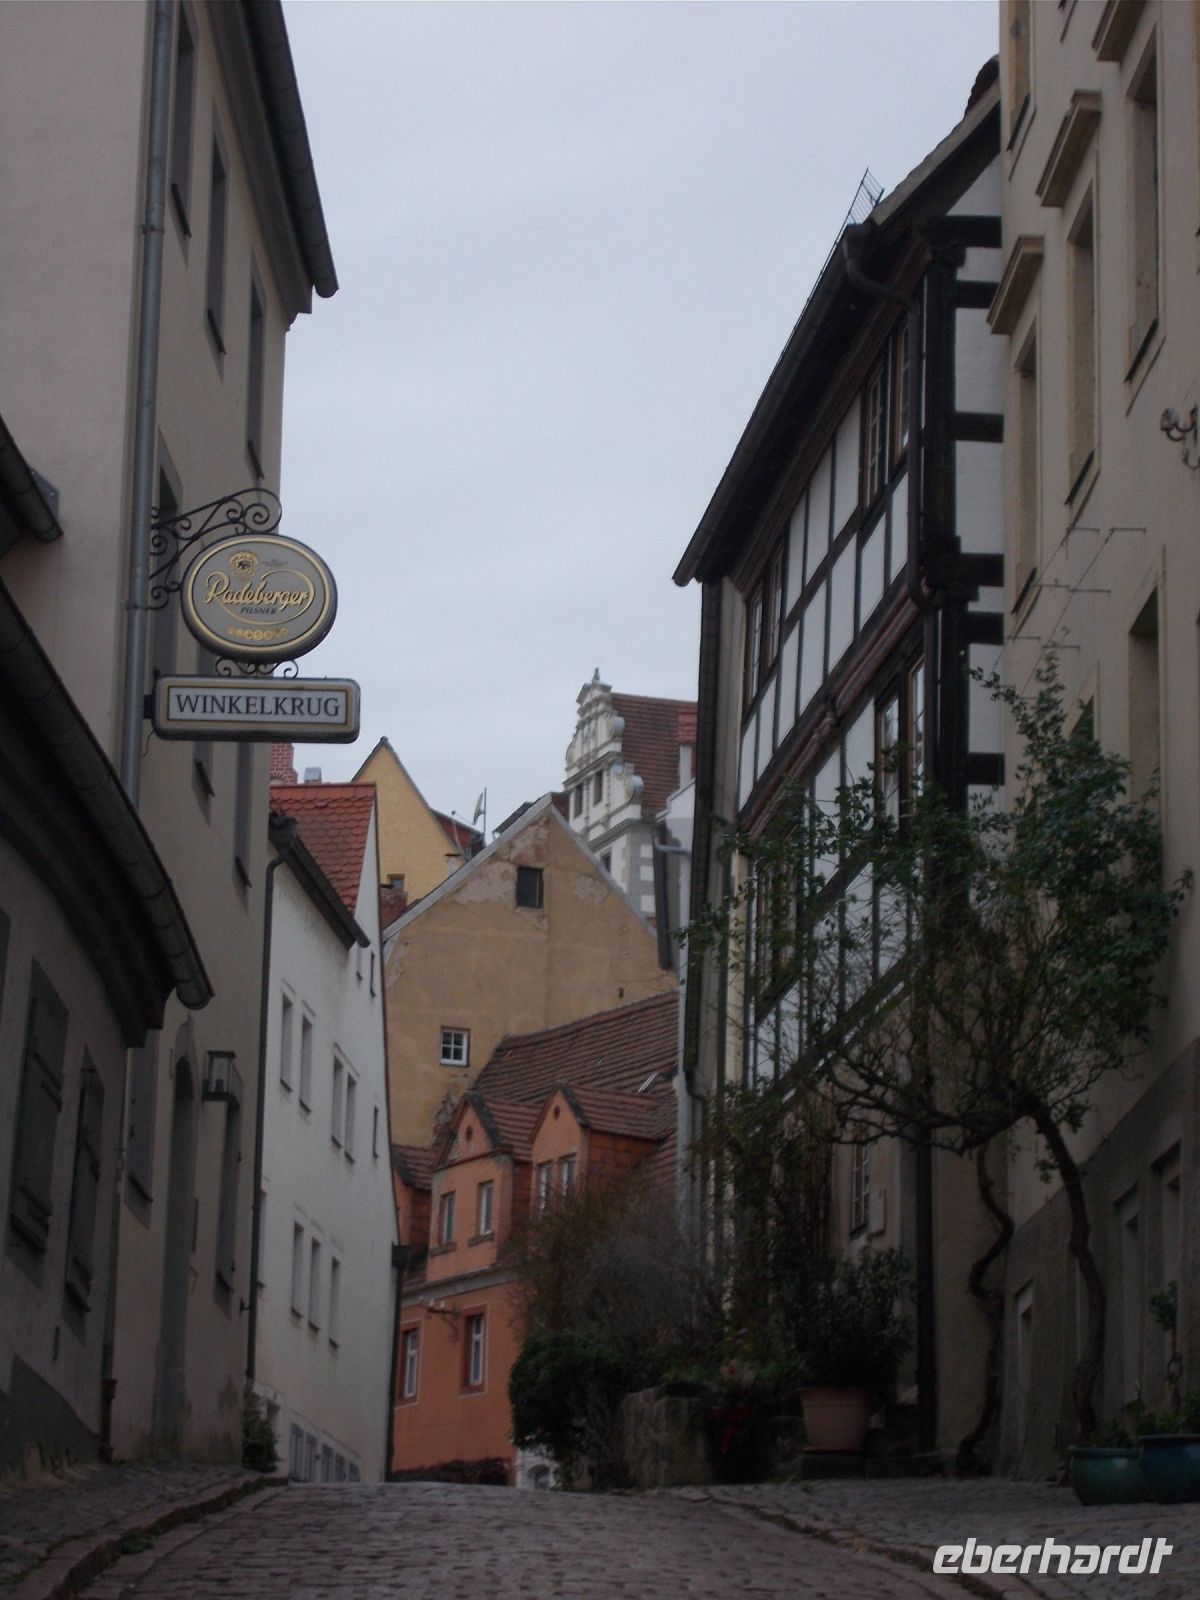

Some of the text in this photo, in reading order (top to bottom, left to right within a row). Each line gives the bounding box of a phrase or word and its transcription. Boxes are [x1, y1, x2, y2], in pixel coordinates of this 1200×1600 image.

[204, 570, 313, 612] Radeberger
[240, 606, 278, 616] PILSNER
[176, 694, 341, 717] WINKELKRUG
